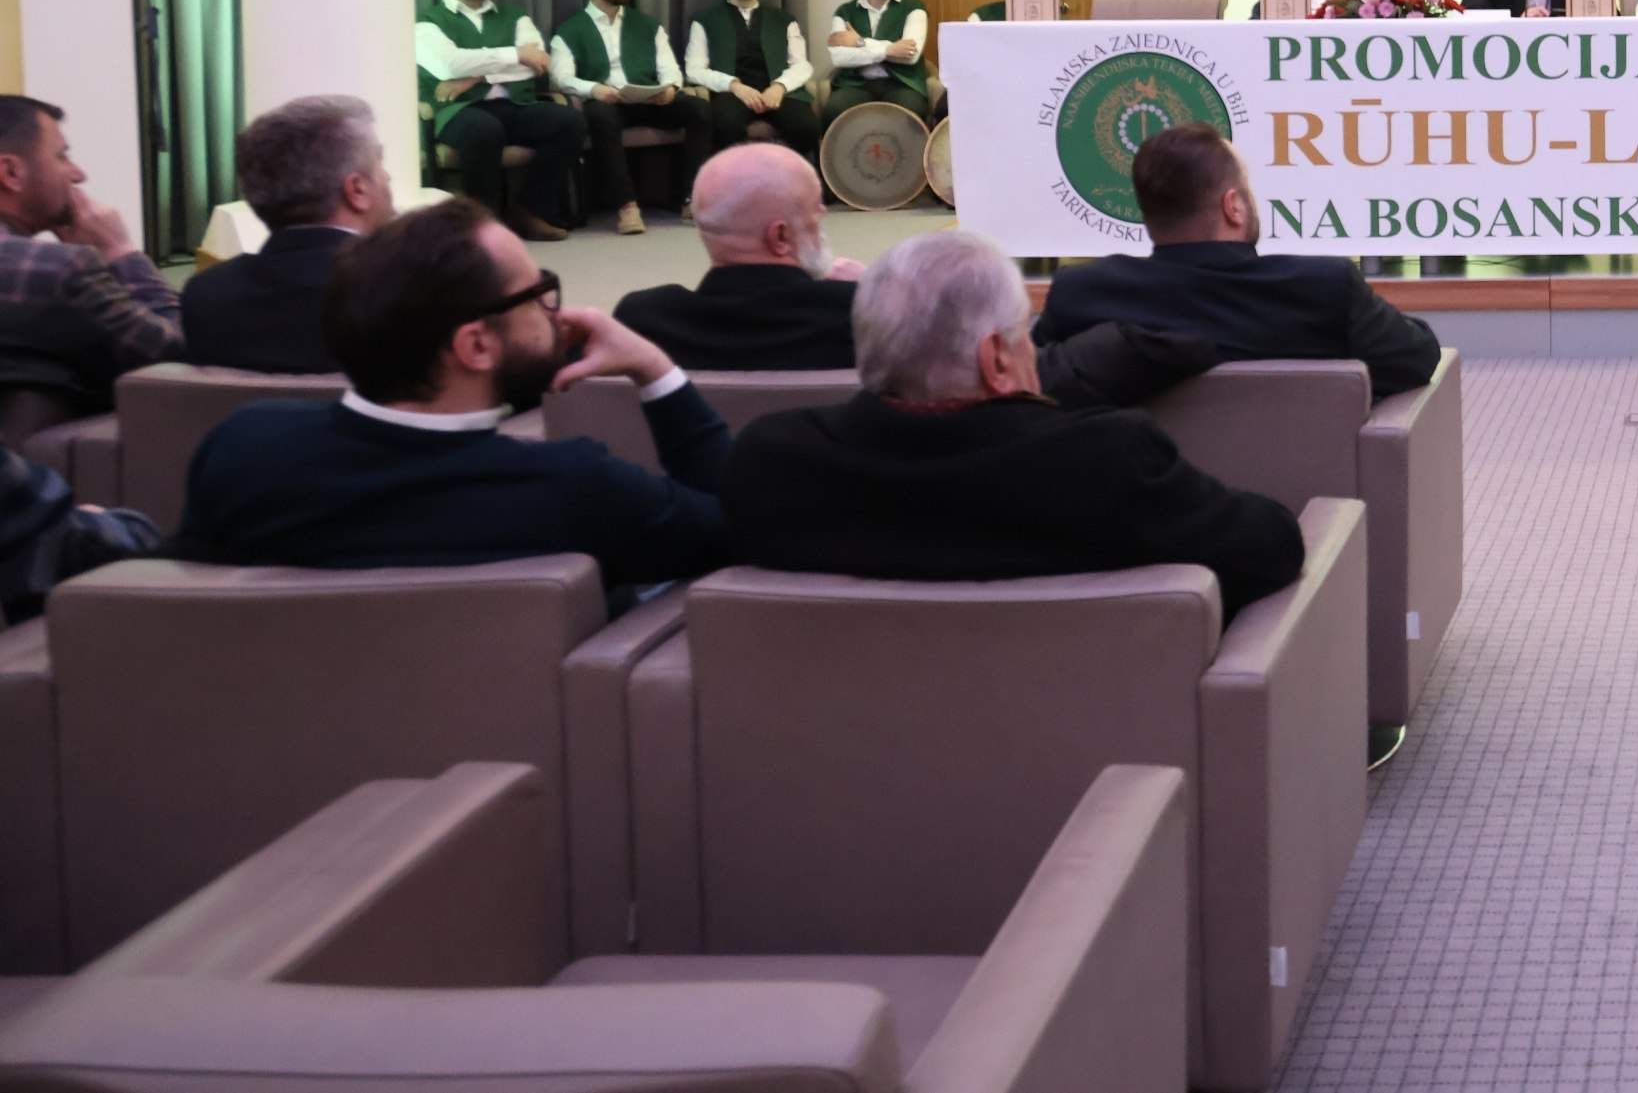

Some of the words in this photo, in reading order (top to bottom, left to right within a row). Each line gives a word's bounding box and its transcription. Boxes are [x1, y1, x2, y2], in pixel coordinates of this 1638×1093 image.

[1038, 44, 1107, 127] ISLAMSKA
[1109, 33, 1217, 77] ZAJEDNICA
[1216, 73, 1235, 89] U
[1226, 91, 1249, 126] BiH
[1051, 177, 1144, 242] TARIKATSKI
[1268, 198, 1350, 239] NA
